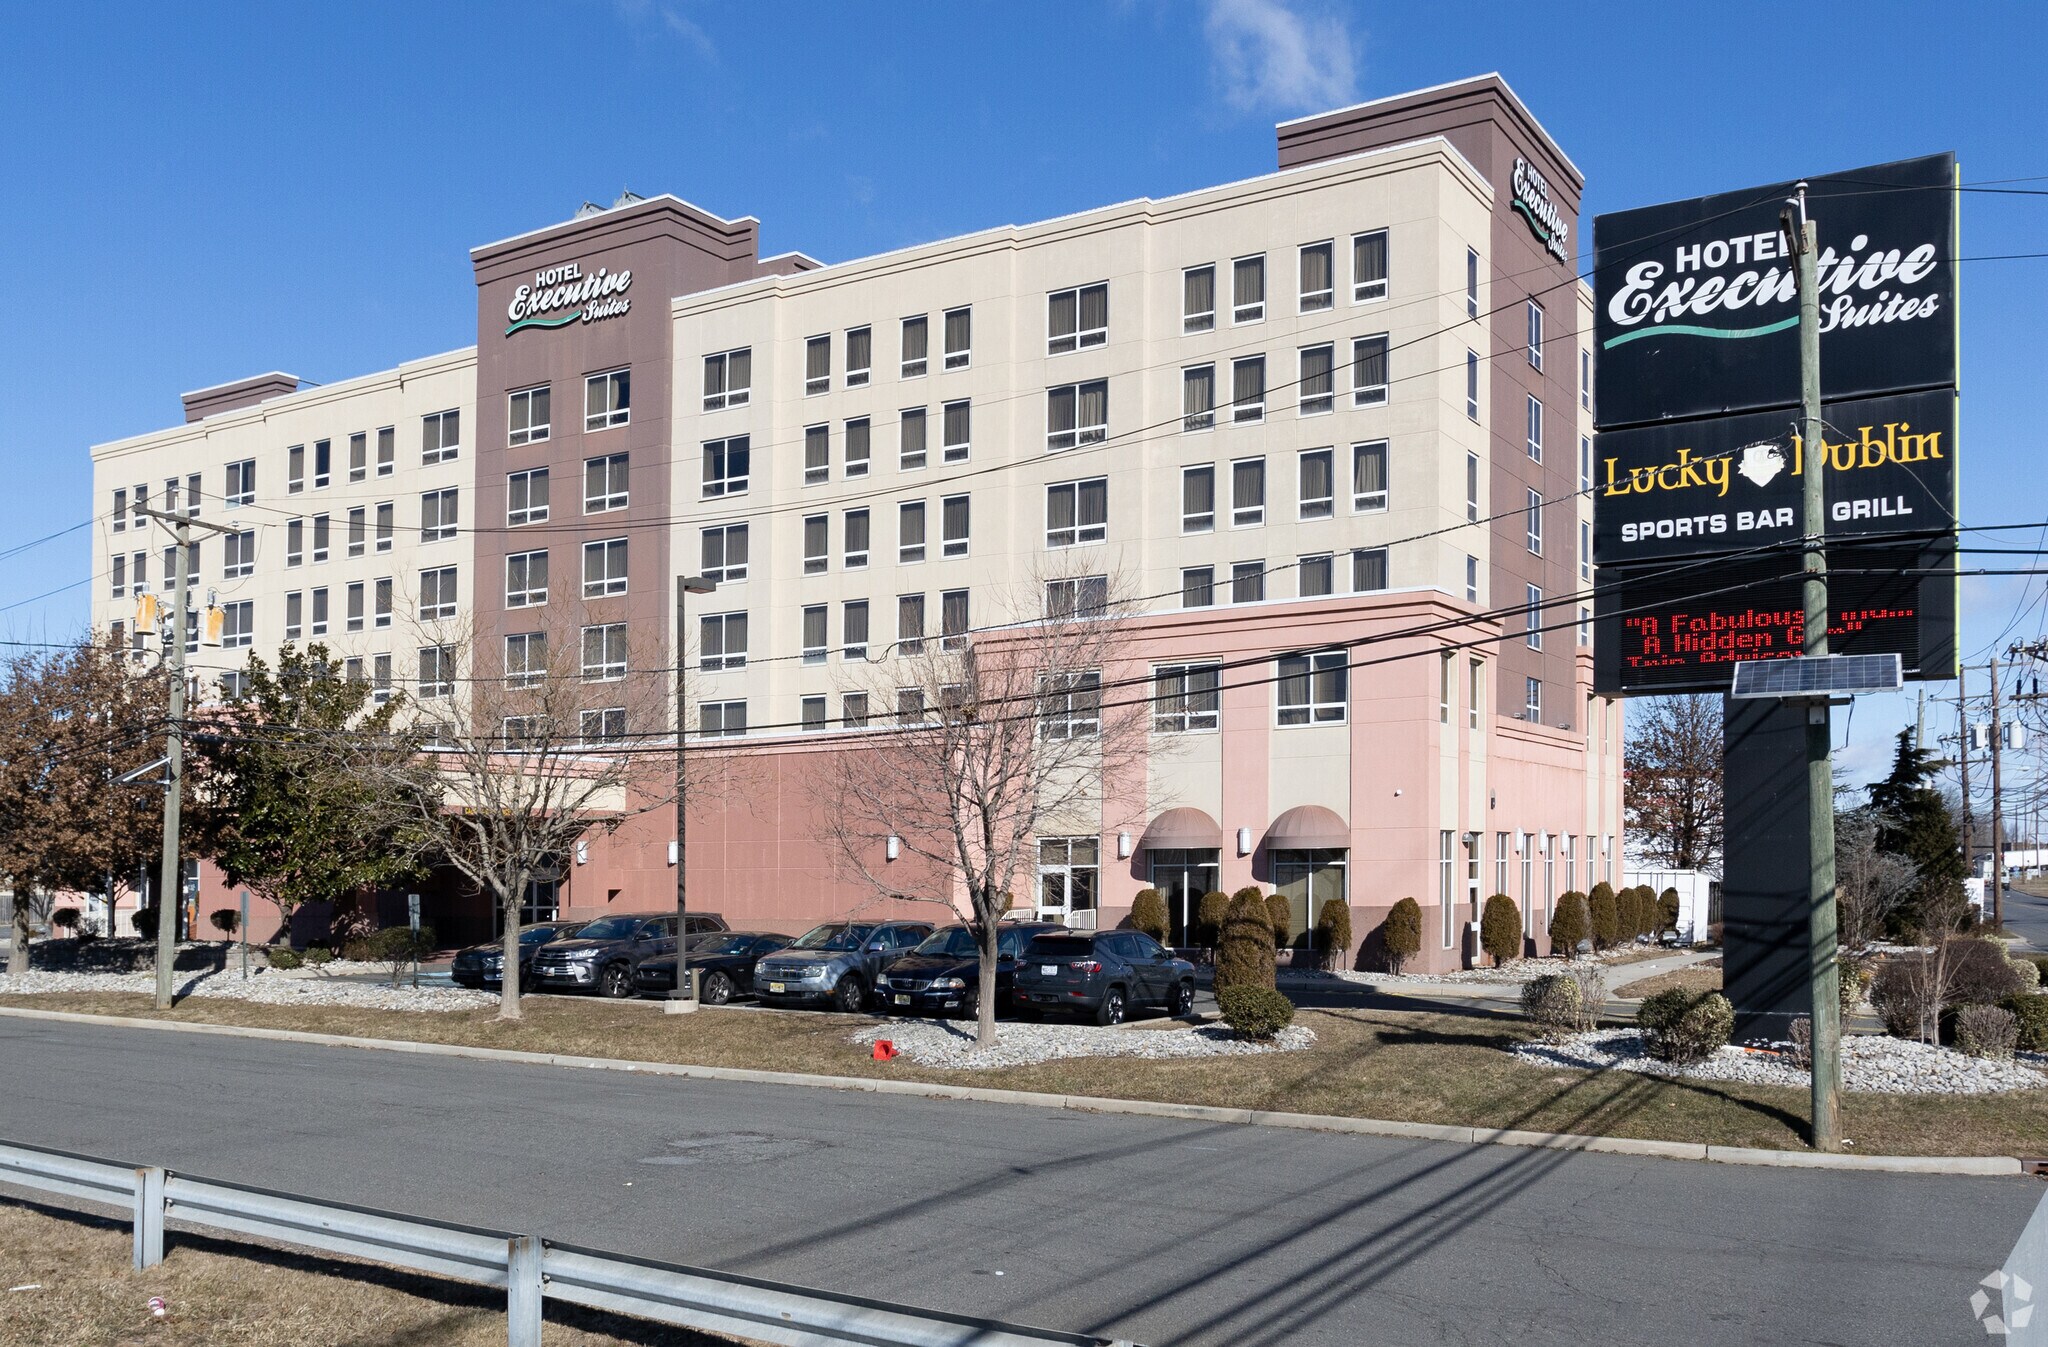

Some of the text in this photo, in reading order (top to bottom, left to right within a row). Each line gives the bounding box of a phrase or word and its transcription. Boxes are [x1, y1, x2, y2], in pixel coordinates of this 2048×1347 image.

[1513, 158, 1568, 242] Executive
[1527, 163, 1548, 200] HOTEL
[1548, 232, 1568, 262] Suites
[536, 263, 582, 287] HOTEL
[508, 267, 632, 321] Executive
[582, 298, 629, 321] Suites
[1818, 291, 1939, 333] Suites
[1604, 448, 1733, 497] Lucky
[1621, 496, 1912, 542] SPORTS BAR GRILL
[1671, 609, 1804, 633] Fabulous
[1644, 636, 1660, 654] A
[1674, 630, 1772, 653] Hidden
